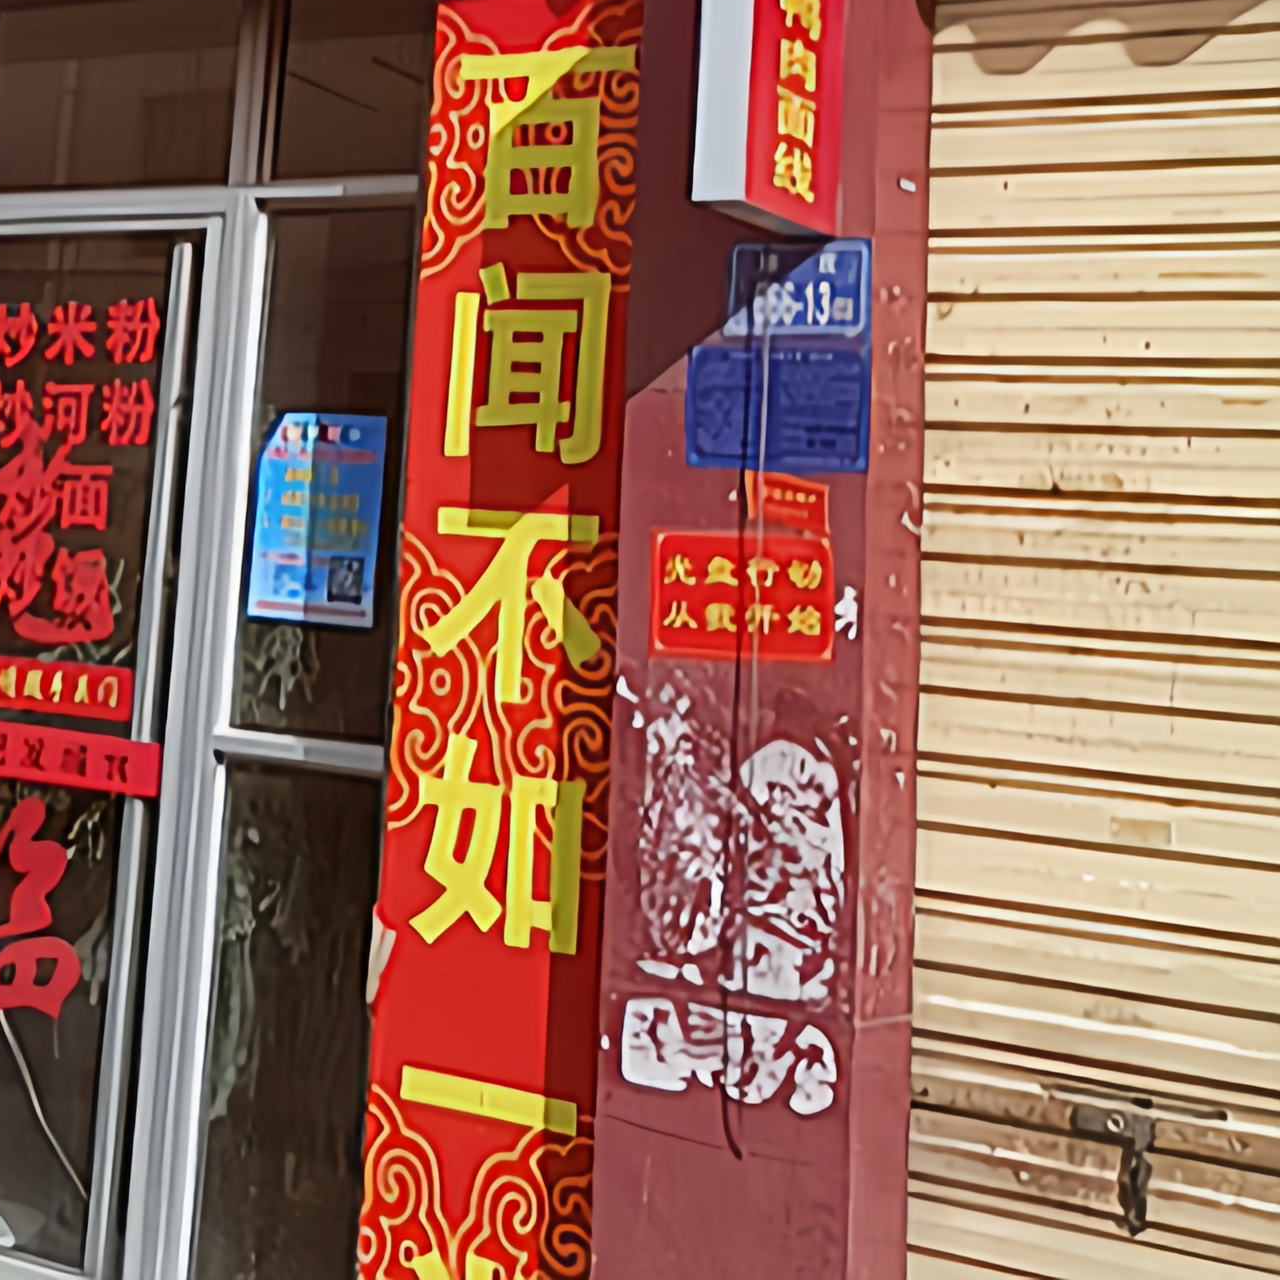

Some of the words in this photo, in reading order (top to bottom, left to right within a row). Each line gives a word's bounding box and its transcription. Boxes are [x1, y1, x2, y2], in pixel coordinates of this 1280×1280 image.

[400, 46, 636, 1280] 百闻不如一
